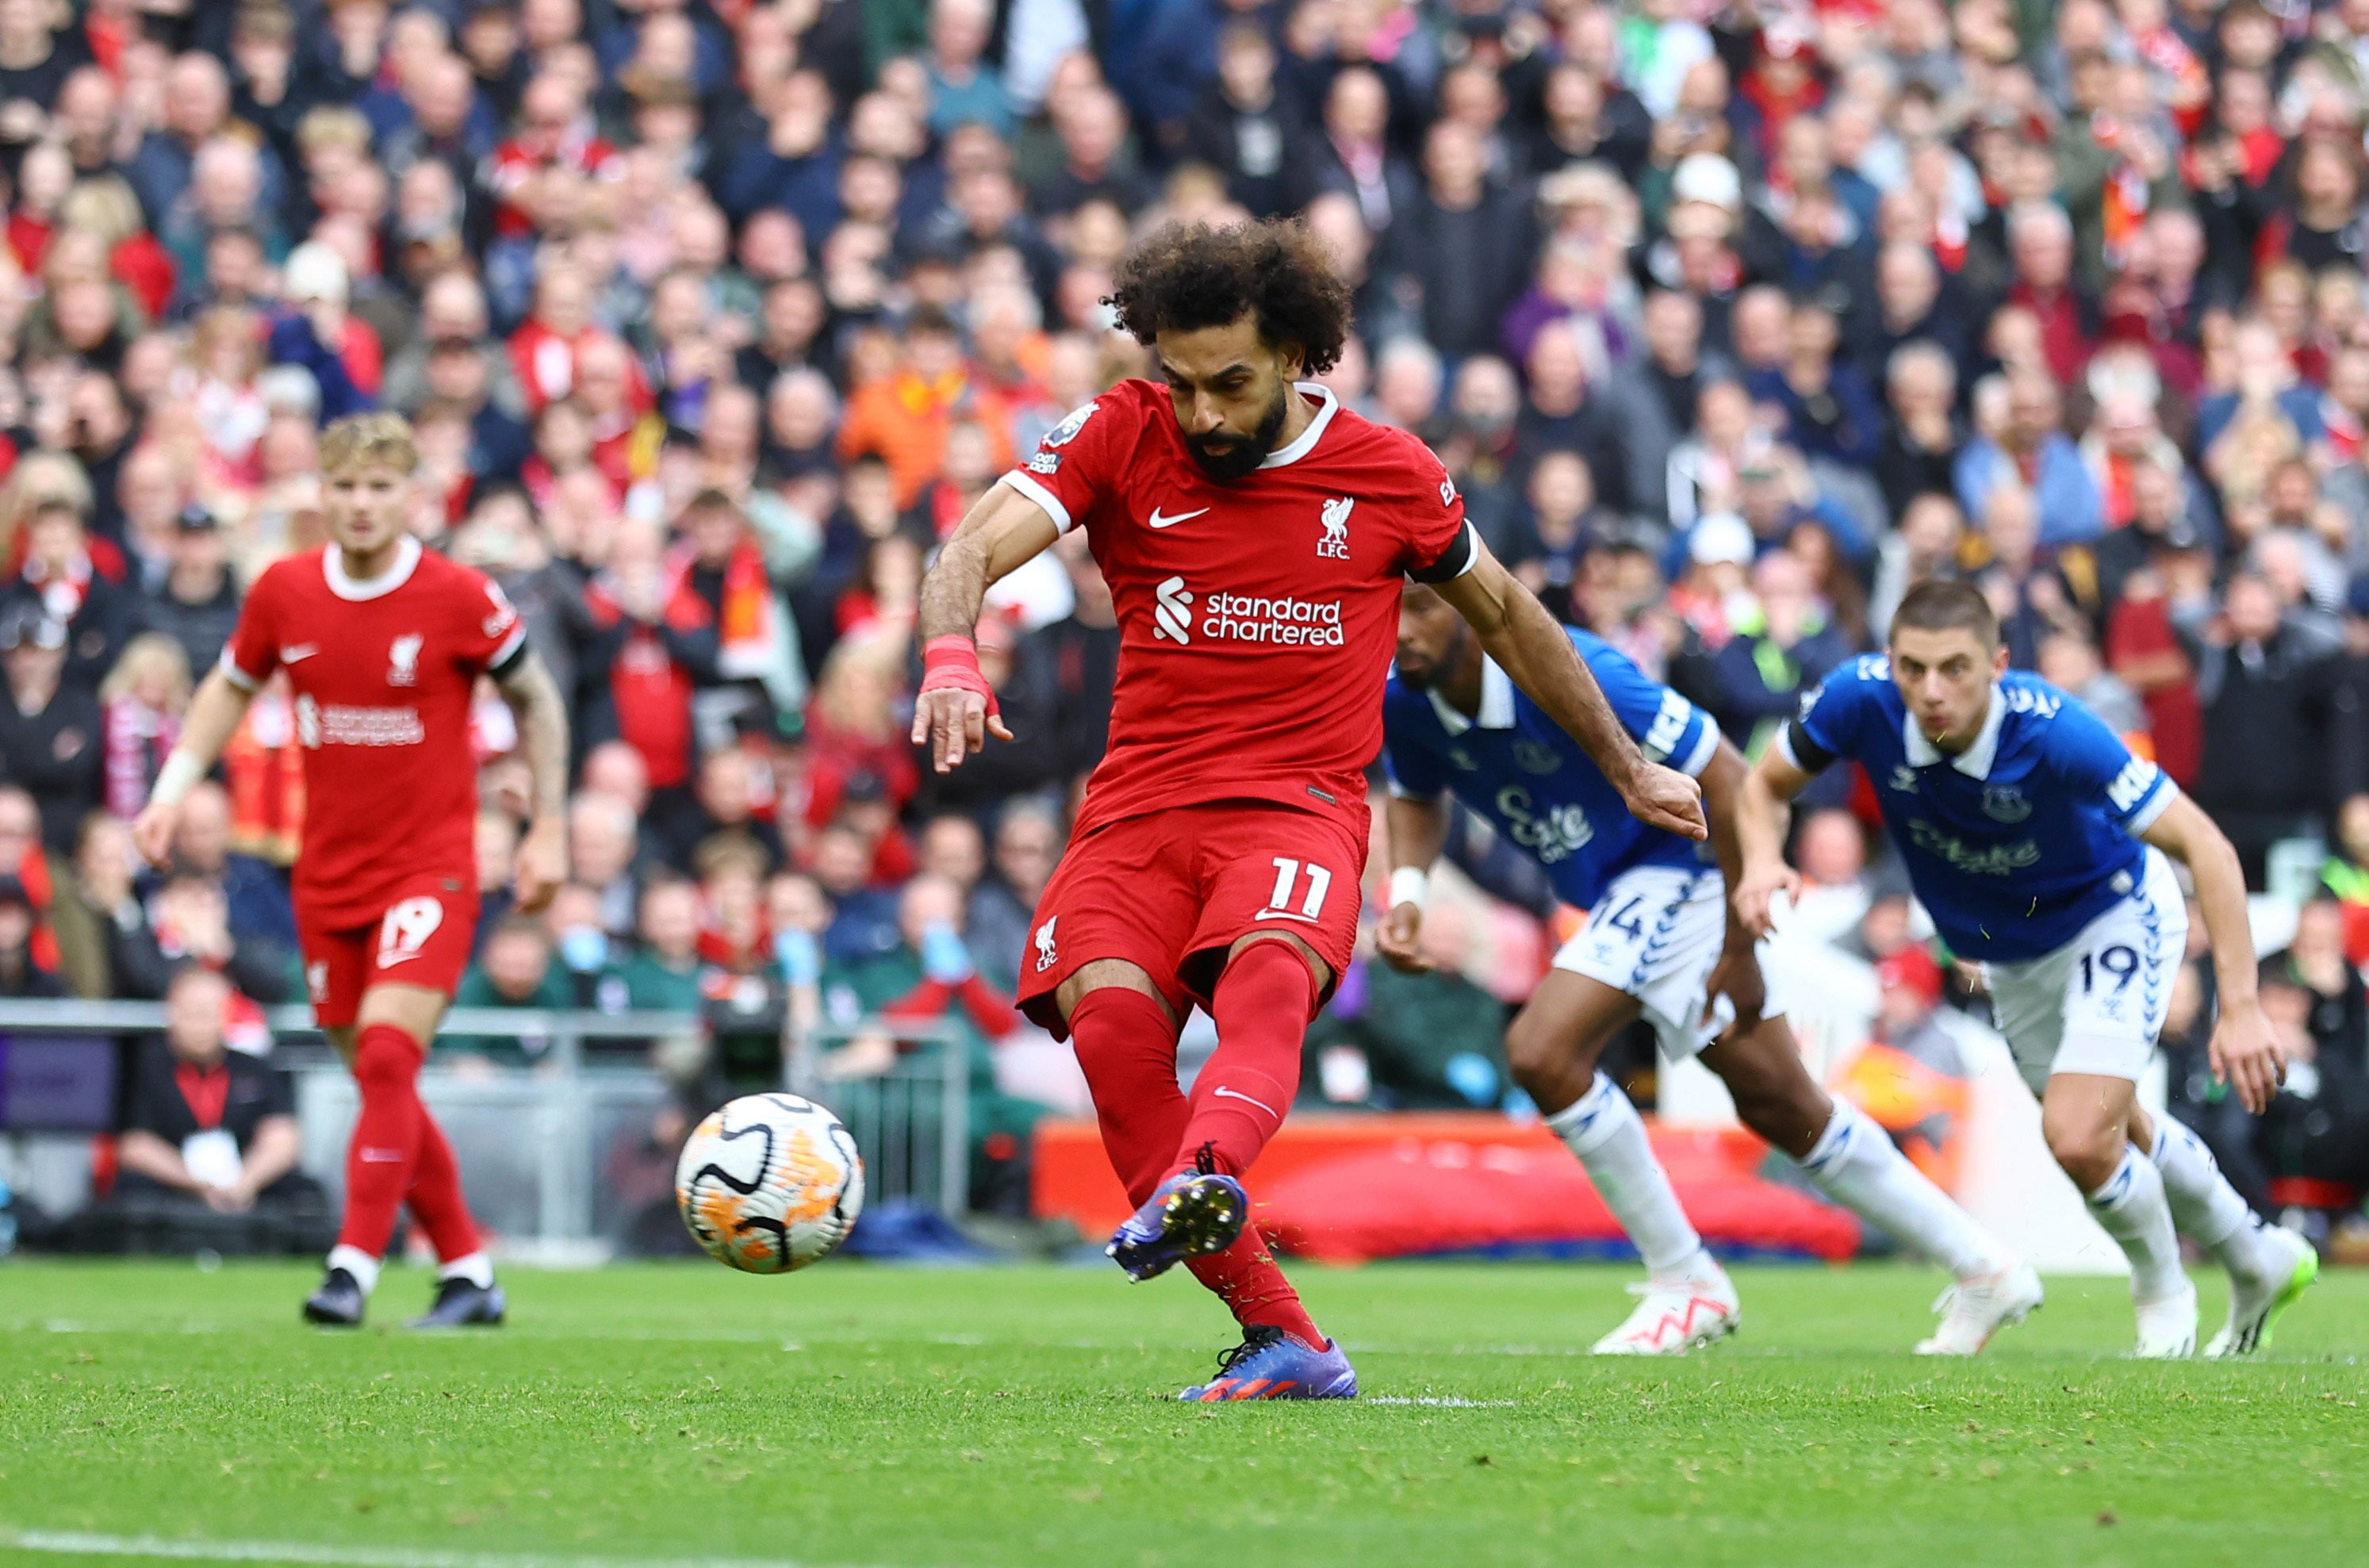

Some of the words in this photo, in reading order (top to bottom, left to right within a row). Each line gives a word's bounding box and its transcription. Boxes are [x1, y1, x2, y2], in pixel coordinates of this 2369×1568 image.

[1202, 615, 1344, 646] chartered
[1206, 592, 1340, 624] standard
[1269, 857, 1332, 919] 11
[378, 896, 444, 953] 19
[2080, 945, 2139, 995] 19
